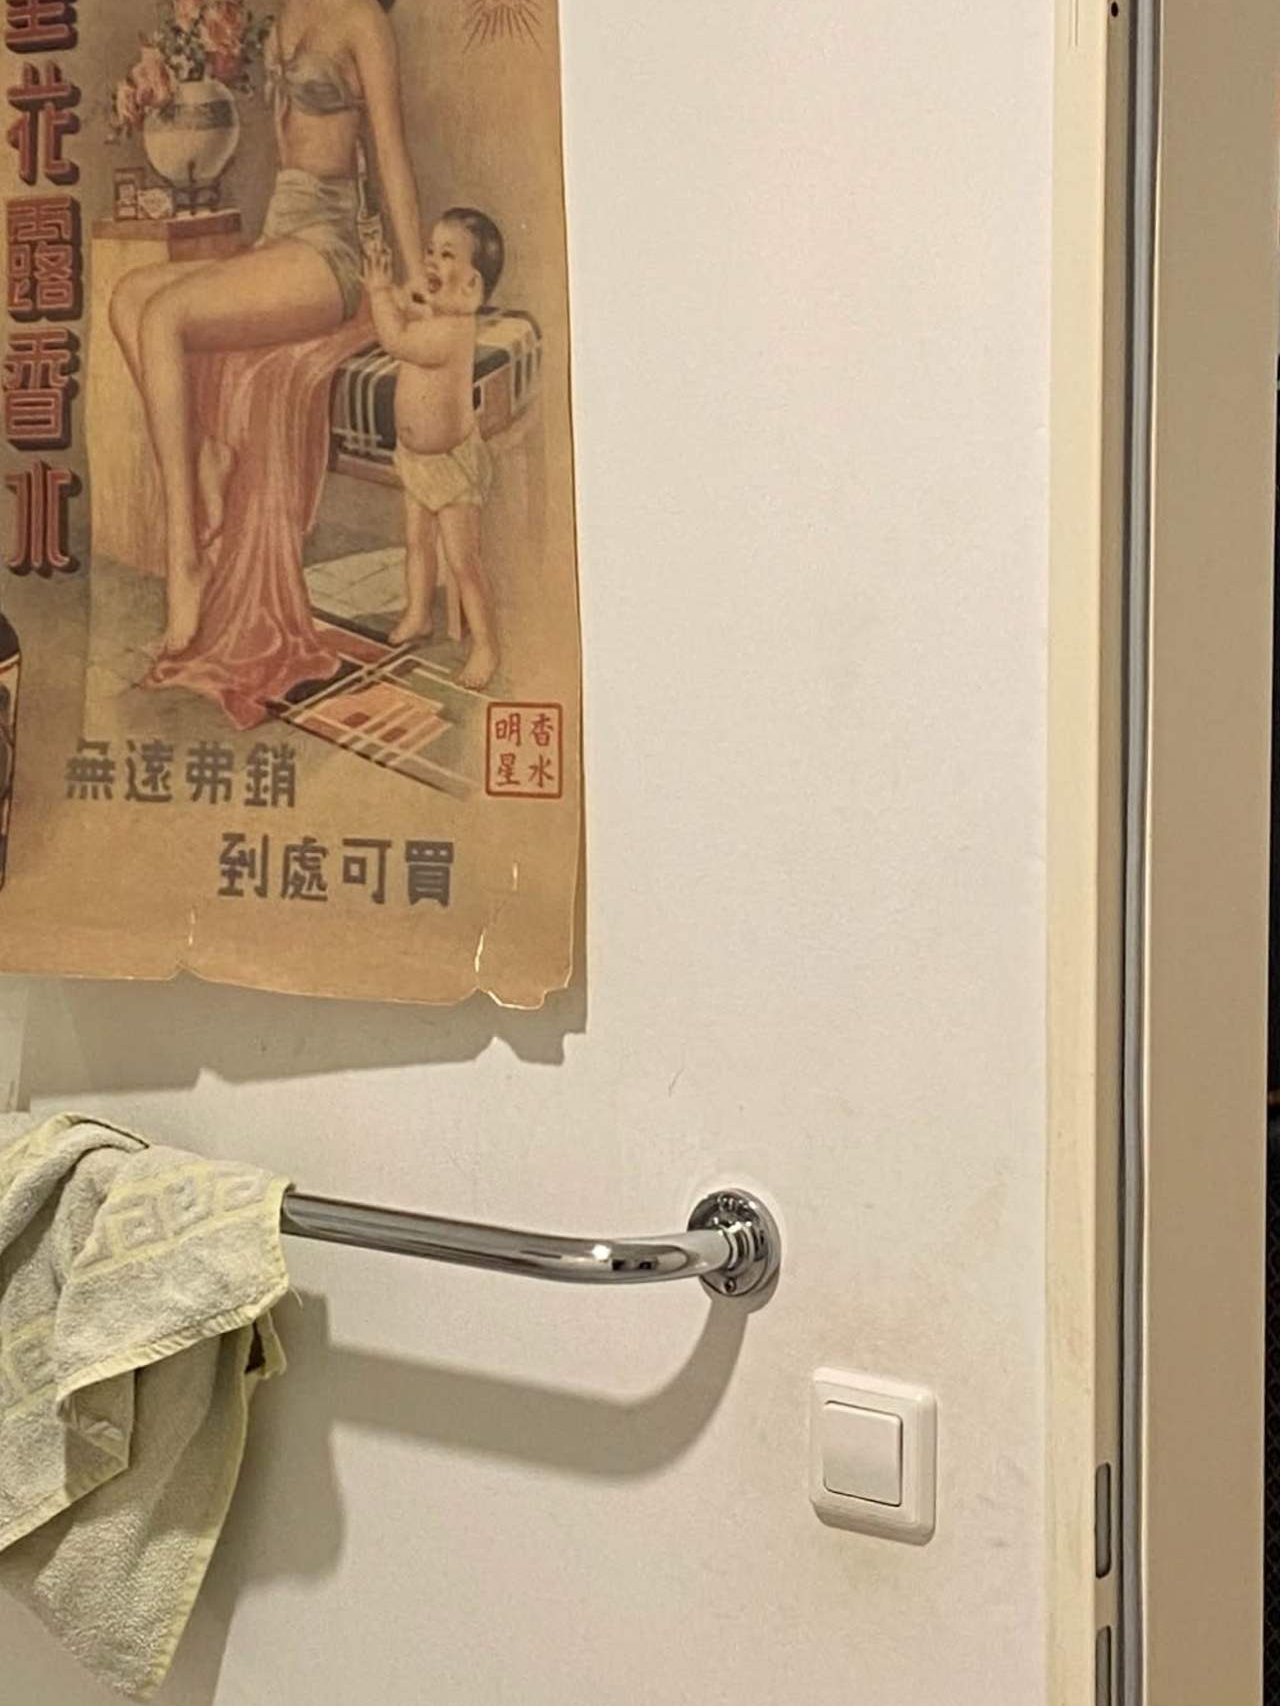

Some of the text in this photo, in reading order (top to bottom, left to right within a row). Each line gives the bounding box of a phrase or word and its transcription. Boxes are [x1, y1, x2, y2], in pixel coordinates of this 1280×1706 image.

[66, 740, 297, 808] 無遠弗銷
[495, 713, 521, 787] 明星
[528, 713, 554, 788] 香水
[217, 833, 454, 907] 到處可買
